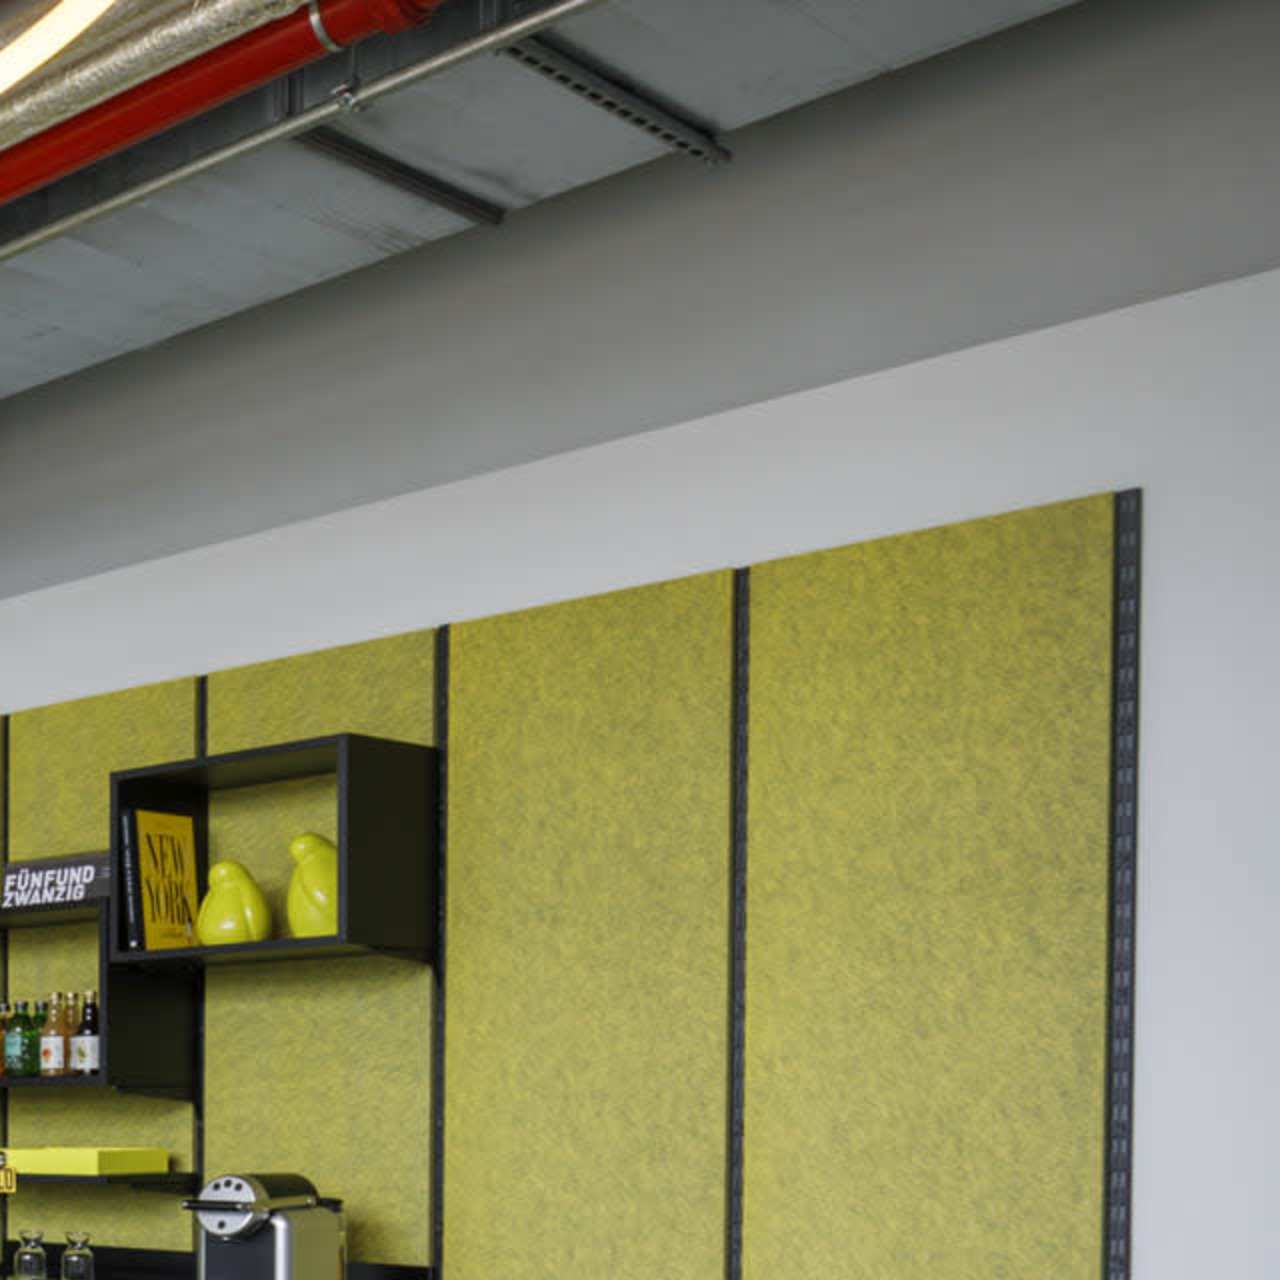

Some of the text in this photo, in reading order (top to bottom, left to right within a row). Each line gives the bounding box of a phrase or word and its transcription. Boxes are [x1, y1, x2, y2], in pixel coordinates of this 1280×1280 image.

[145, 832, 186, 878] NEW
[4, 865, 96, 892] FÜNFUND
[1, 883, 86, 908] ZWANZIG
